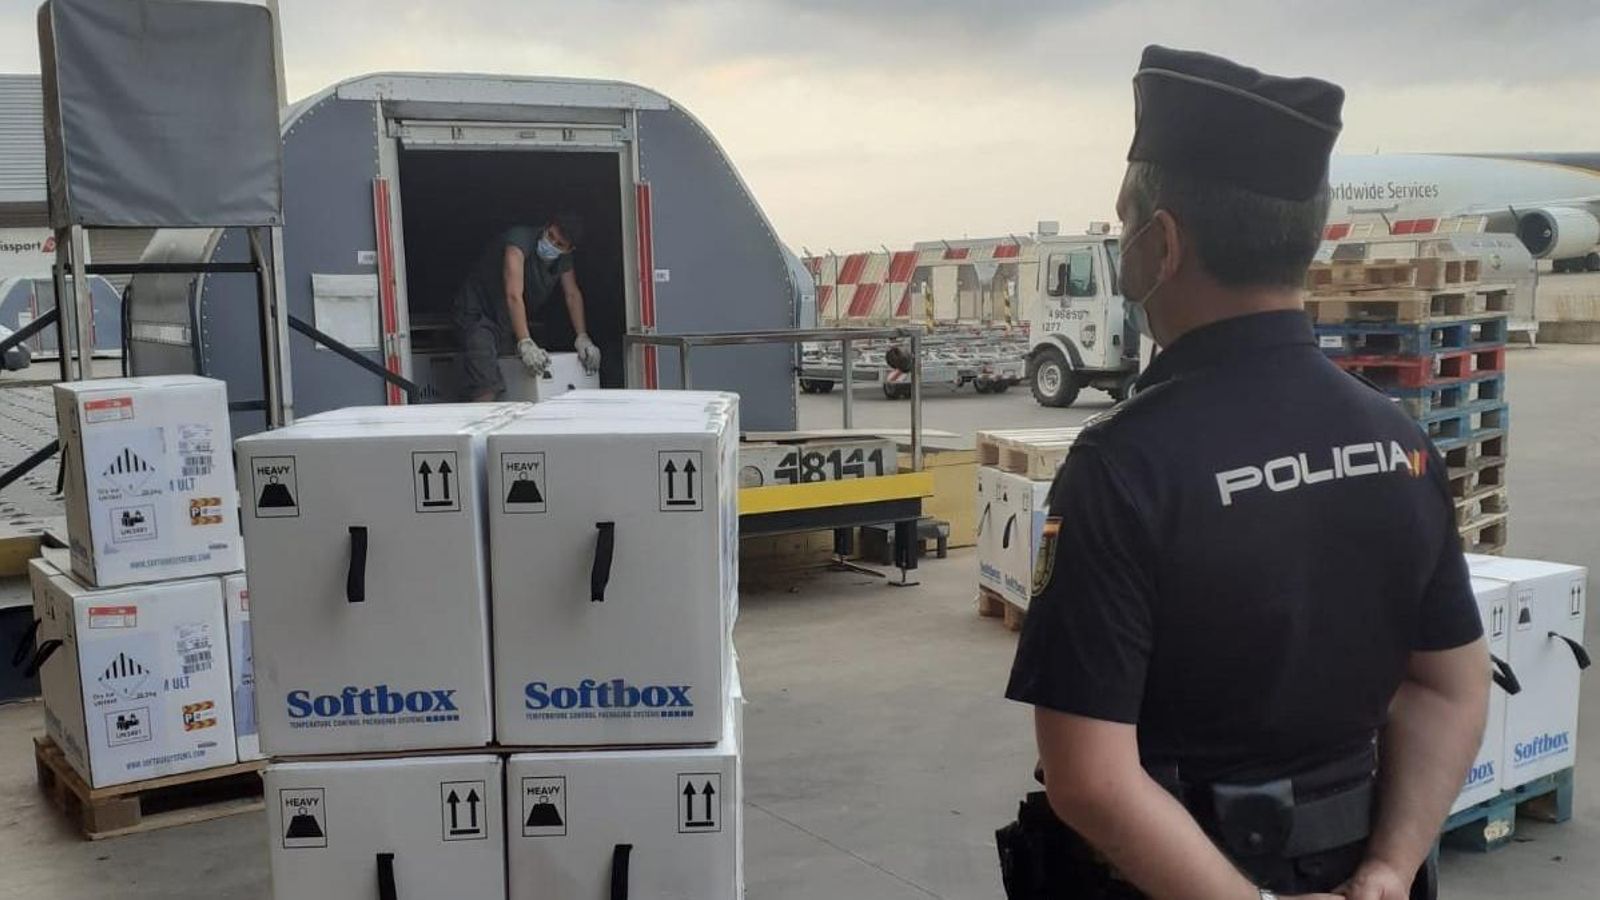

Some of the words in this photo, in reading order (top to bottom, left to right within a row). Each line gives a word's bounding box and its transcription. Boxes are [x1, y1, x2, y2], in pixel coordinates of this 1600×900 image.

[1330, 182, 1384, 200] orldwide
[1387, 180, 1439, 199] Services
[0, 241, 41, 253] issport
[257, 466, 290, 476] HEAVY
[506, 462, 539, 472] HEAVY
[774, 448, 883, 485] 48141
[1216, 440, 1412, 506] POLICIA
[286, 684, 459, 719] Softbox
[524, 679, 693, 710] Softbox
[1513, 731, 1569, 763] Softbox
[527, 785, 560, 796] HEAVY
[285, 797, 319, 807] HEAVY
